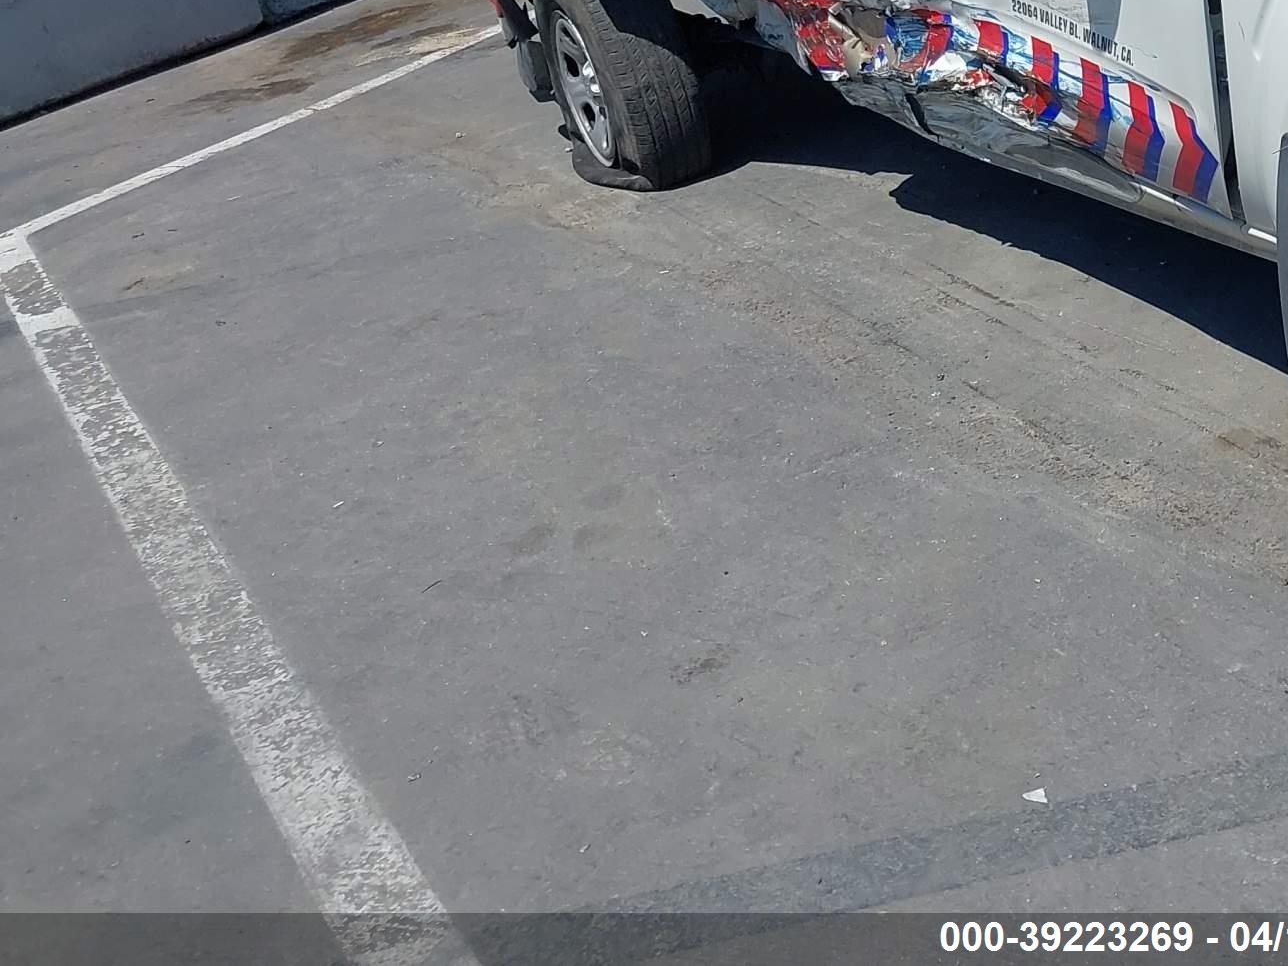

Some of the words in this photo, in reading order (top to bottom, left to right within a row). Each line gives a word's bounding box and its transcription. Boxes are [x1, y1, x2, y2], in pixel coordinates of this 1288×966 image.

[1039, 8, 1068, 34] VALLEY
[1069, 21, 1081, 40] BL.
[1082, 27, 1119, 61] WALNUT,
[1120, 46, 1134, 67] CA.
